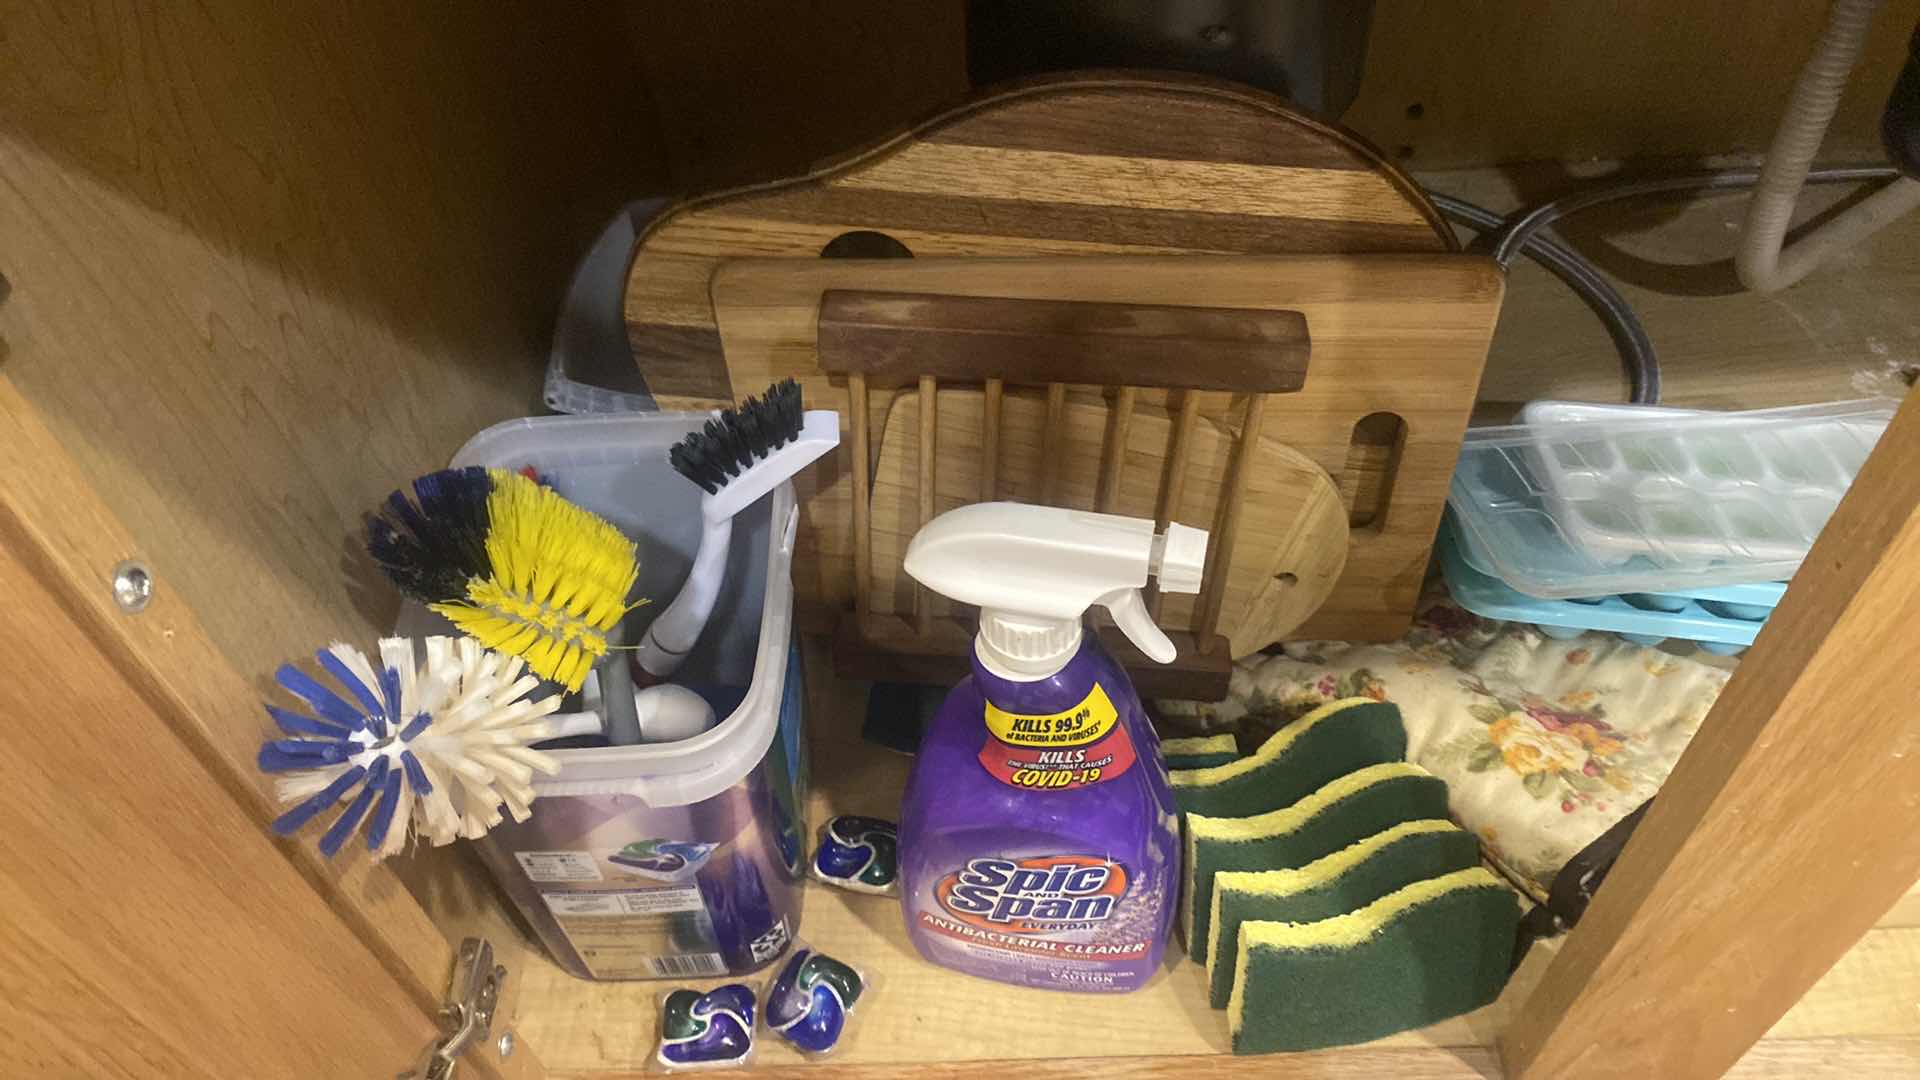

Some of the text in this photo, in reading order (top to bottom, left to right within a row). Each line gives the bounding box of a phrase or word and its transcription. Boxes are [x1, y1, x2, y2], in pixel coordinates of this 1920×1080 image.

[1012, 718, 1051, 733] KILLS
[1015, 734, 1049, 742] BACTERIA
[1051, 734, 1067, 742] AND
[1038, 750, 1086, 763] KILLS
[1080, 756, 1112, 768] CAUSES
[1011, 768, 1101, 787] COVID-19
[961, 859, 1108, 896] Spic
[949, 885, 1113, 922] Span
[1022, 922, 1095, 930] EVERYDAY
[923, 914, 1057, 951] ANTIBACTERIAL
[1063, 943, 1145, 955] CLEANER
[1050, 971, 1113, 984] CAUTION
